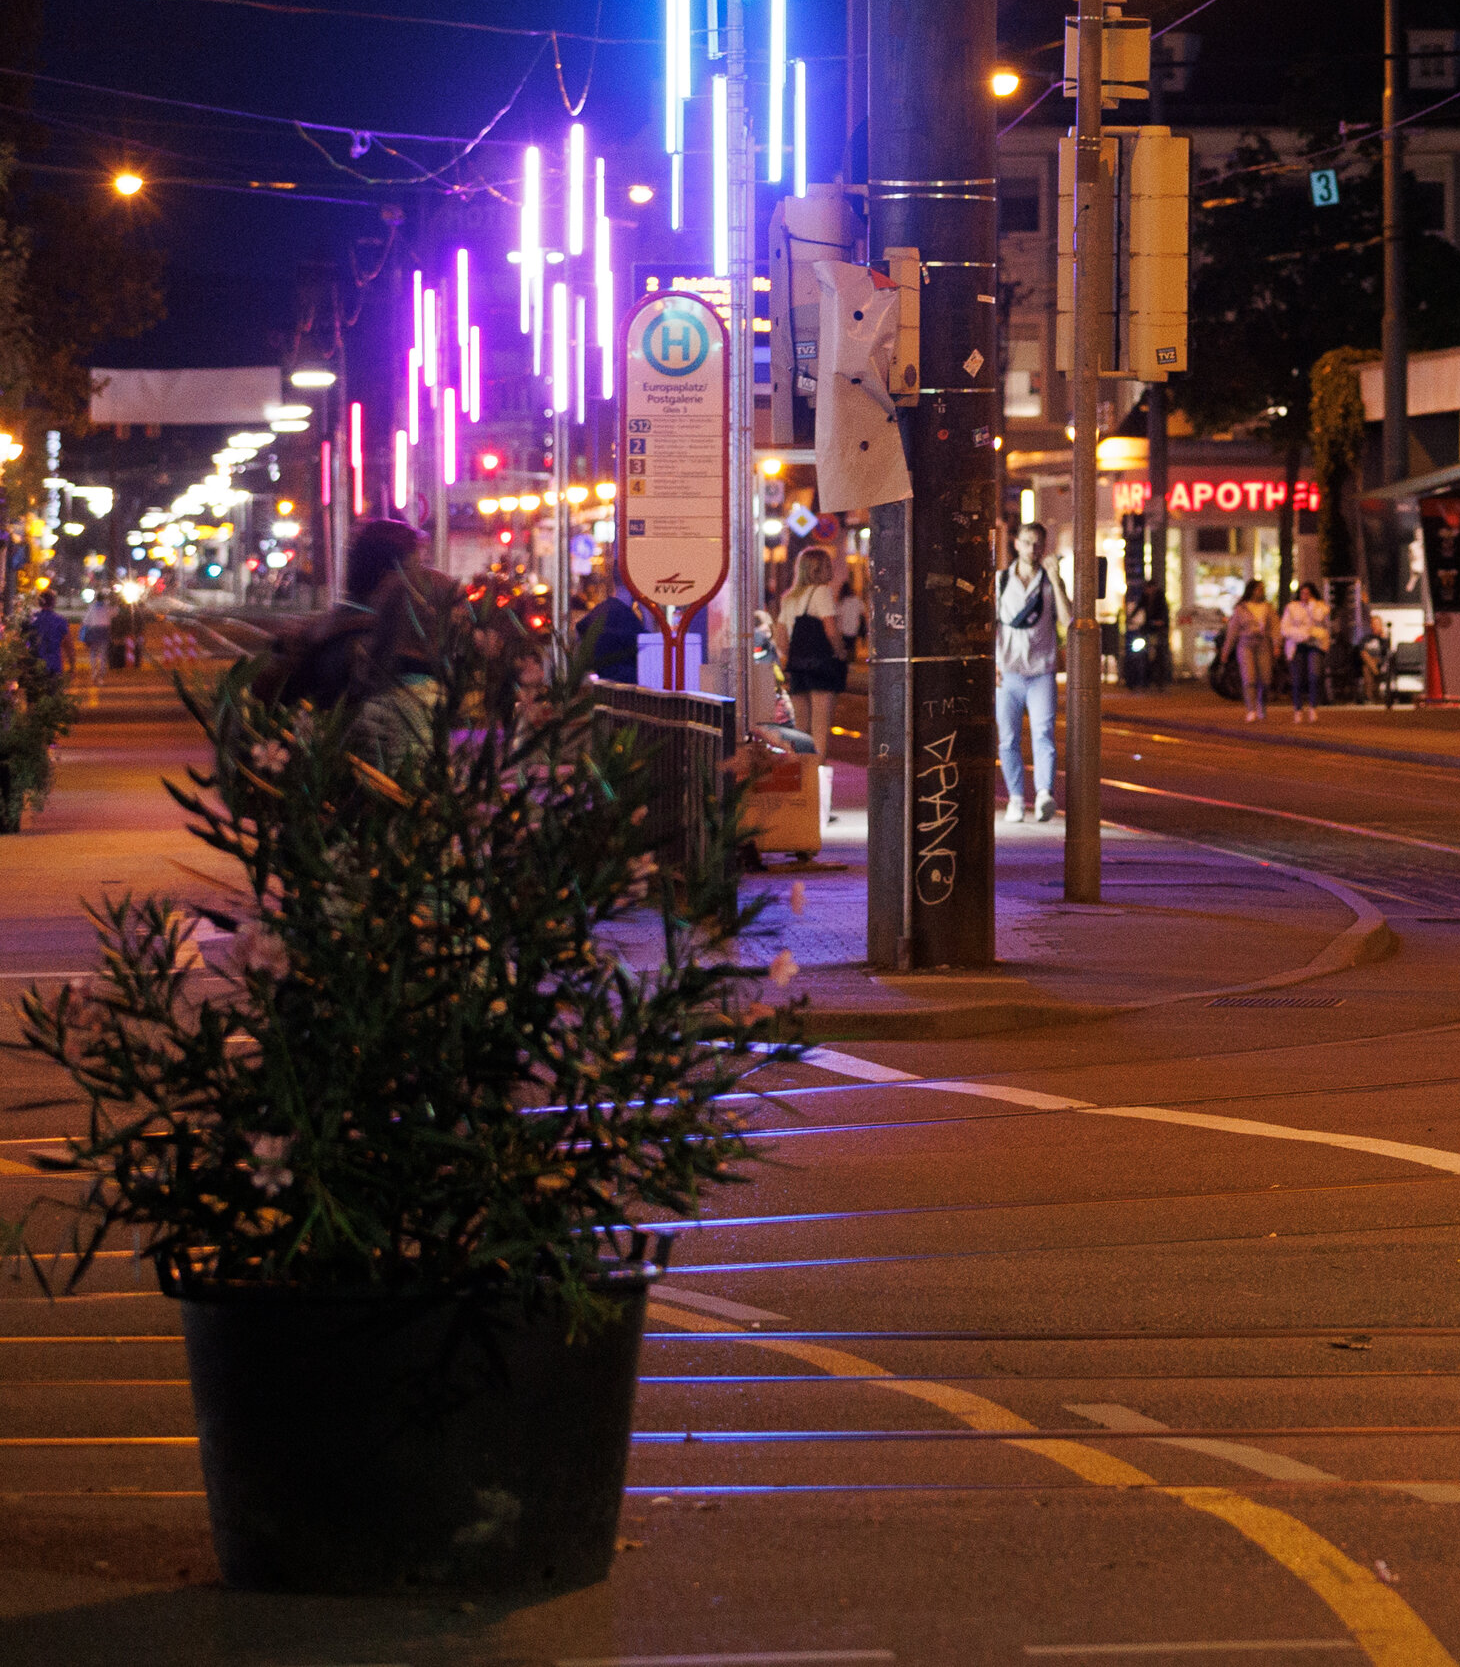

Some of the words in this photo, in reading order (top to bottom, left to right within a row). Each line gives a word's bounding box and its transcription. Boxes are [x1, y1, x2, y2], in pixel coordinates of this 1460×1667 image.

[1317, 174, 1332, 202] 3
[647, 394, 703, 405] Postgalerie
[630, 420, 650, 432] S12
[634, 439, 641, 453] 2
[633, 459, 641, 473] 3
[632, 480, 641, 493] 4
[654, 585, 678, 594] KVV
